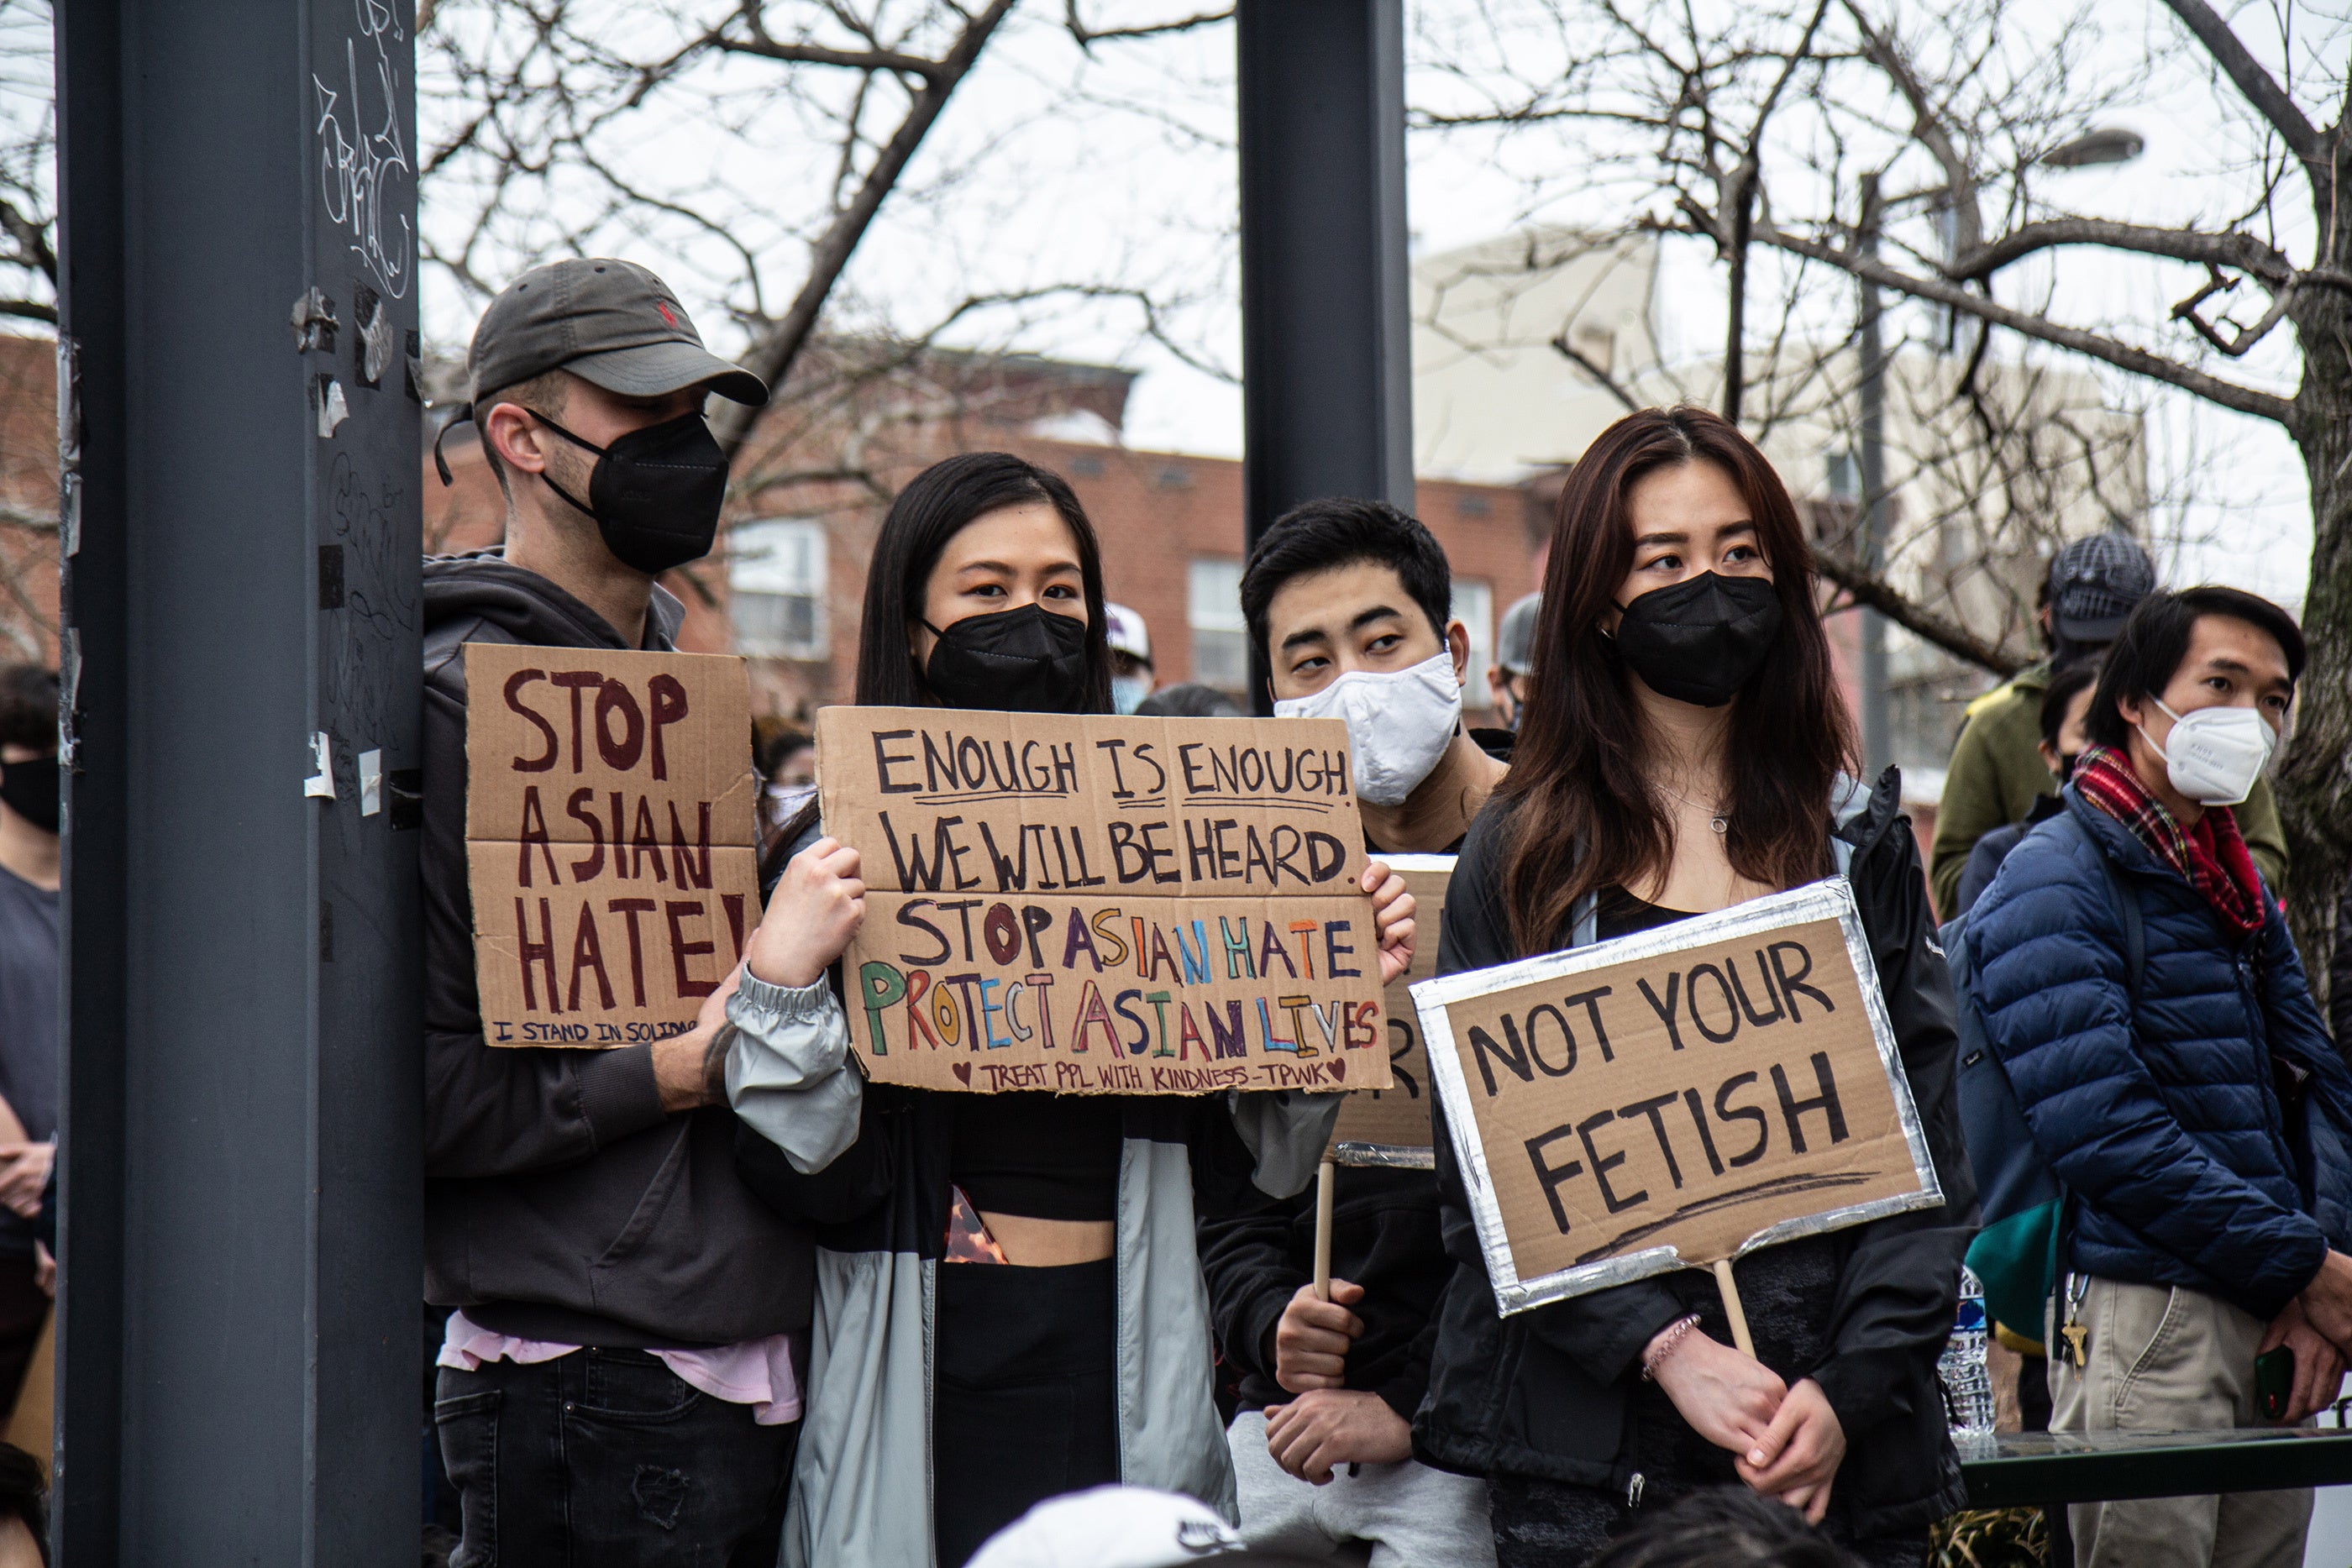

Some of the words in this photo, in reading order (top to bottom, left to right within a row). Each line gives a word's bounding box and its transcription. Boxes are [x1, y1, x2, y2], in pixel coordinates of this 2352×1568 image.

[504, 669, 688, 780] STOP
[871, 730, 1079, 794] ENOUGH
[1096, 739, 1166, 798] IS
[518, 785, 713, 890] ASIAN
[879, 810, 981, 894] WE
[978, 821, 1105, 892] WILL
[1108, 821, 1179, 884] BE
[515, 894, 745, 1014] HATE!
[896, 899, 1053, 968] STOP
[1063, 908, 1212, 988] ASIAN
[1219, 915, 1362, 981] HATE
[492, 1021, 512, 1041] I
[522, 1022, 589, 1042] STAND
[595, 1023, 622, 1041] IN
[860, 961, 1054, 1056] PROTECT
[1071, 980, 1247, 1061] ASIAN
[1255, 995, 1379, 1059] LIVES
[1467, 986, 1616, 1097] NOT
[1635, 941, 1835, 1051] YOUR
[979, 1062, 1047, 1092] TREAT
[1055, 1061, 1092, 1088] PPL
[1097, 1065, 1143, 1089] WITH
[1151, 1065, 1248, 1090] KINDNESS
[1524, 1051, 1850, 1235] FETISH
